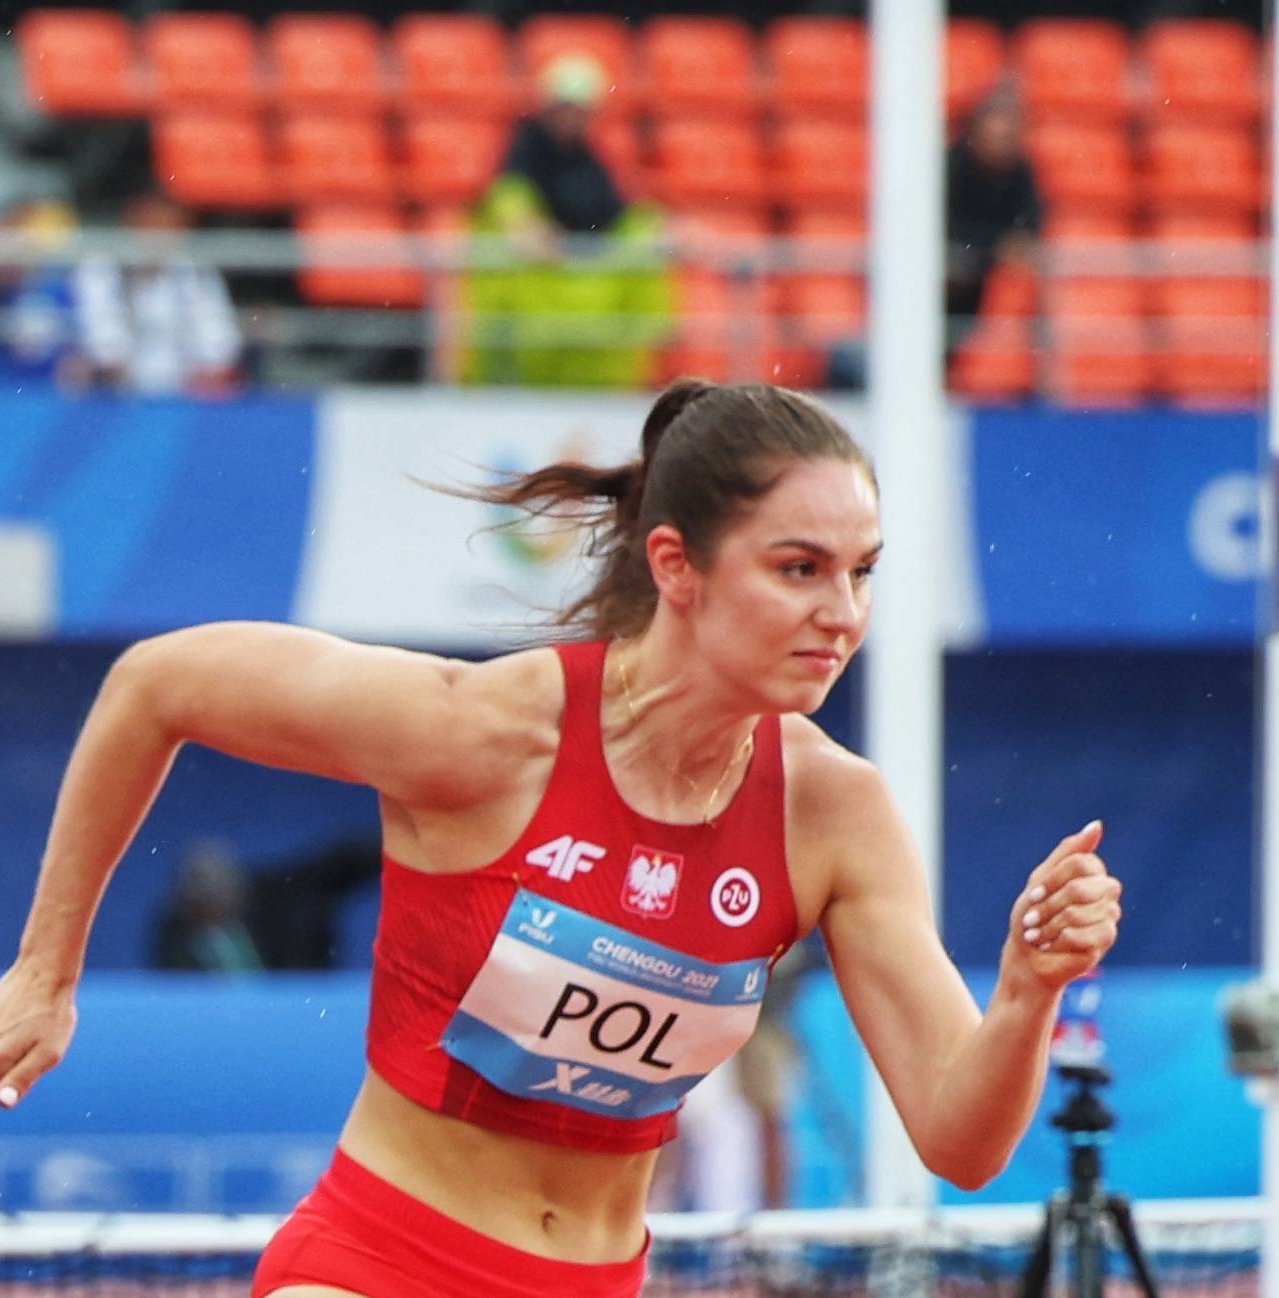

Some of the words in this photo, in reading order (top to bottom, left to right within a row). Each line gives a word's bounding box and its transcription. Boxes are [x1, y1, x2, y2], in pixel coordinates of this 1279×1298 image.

[526, 835, 606, 882] 4F
[591, 935, 682, 978] CHENGDU
[539, 981, 681, 1071] POL
